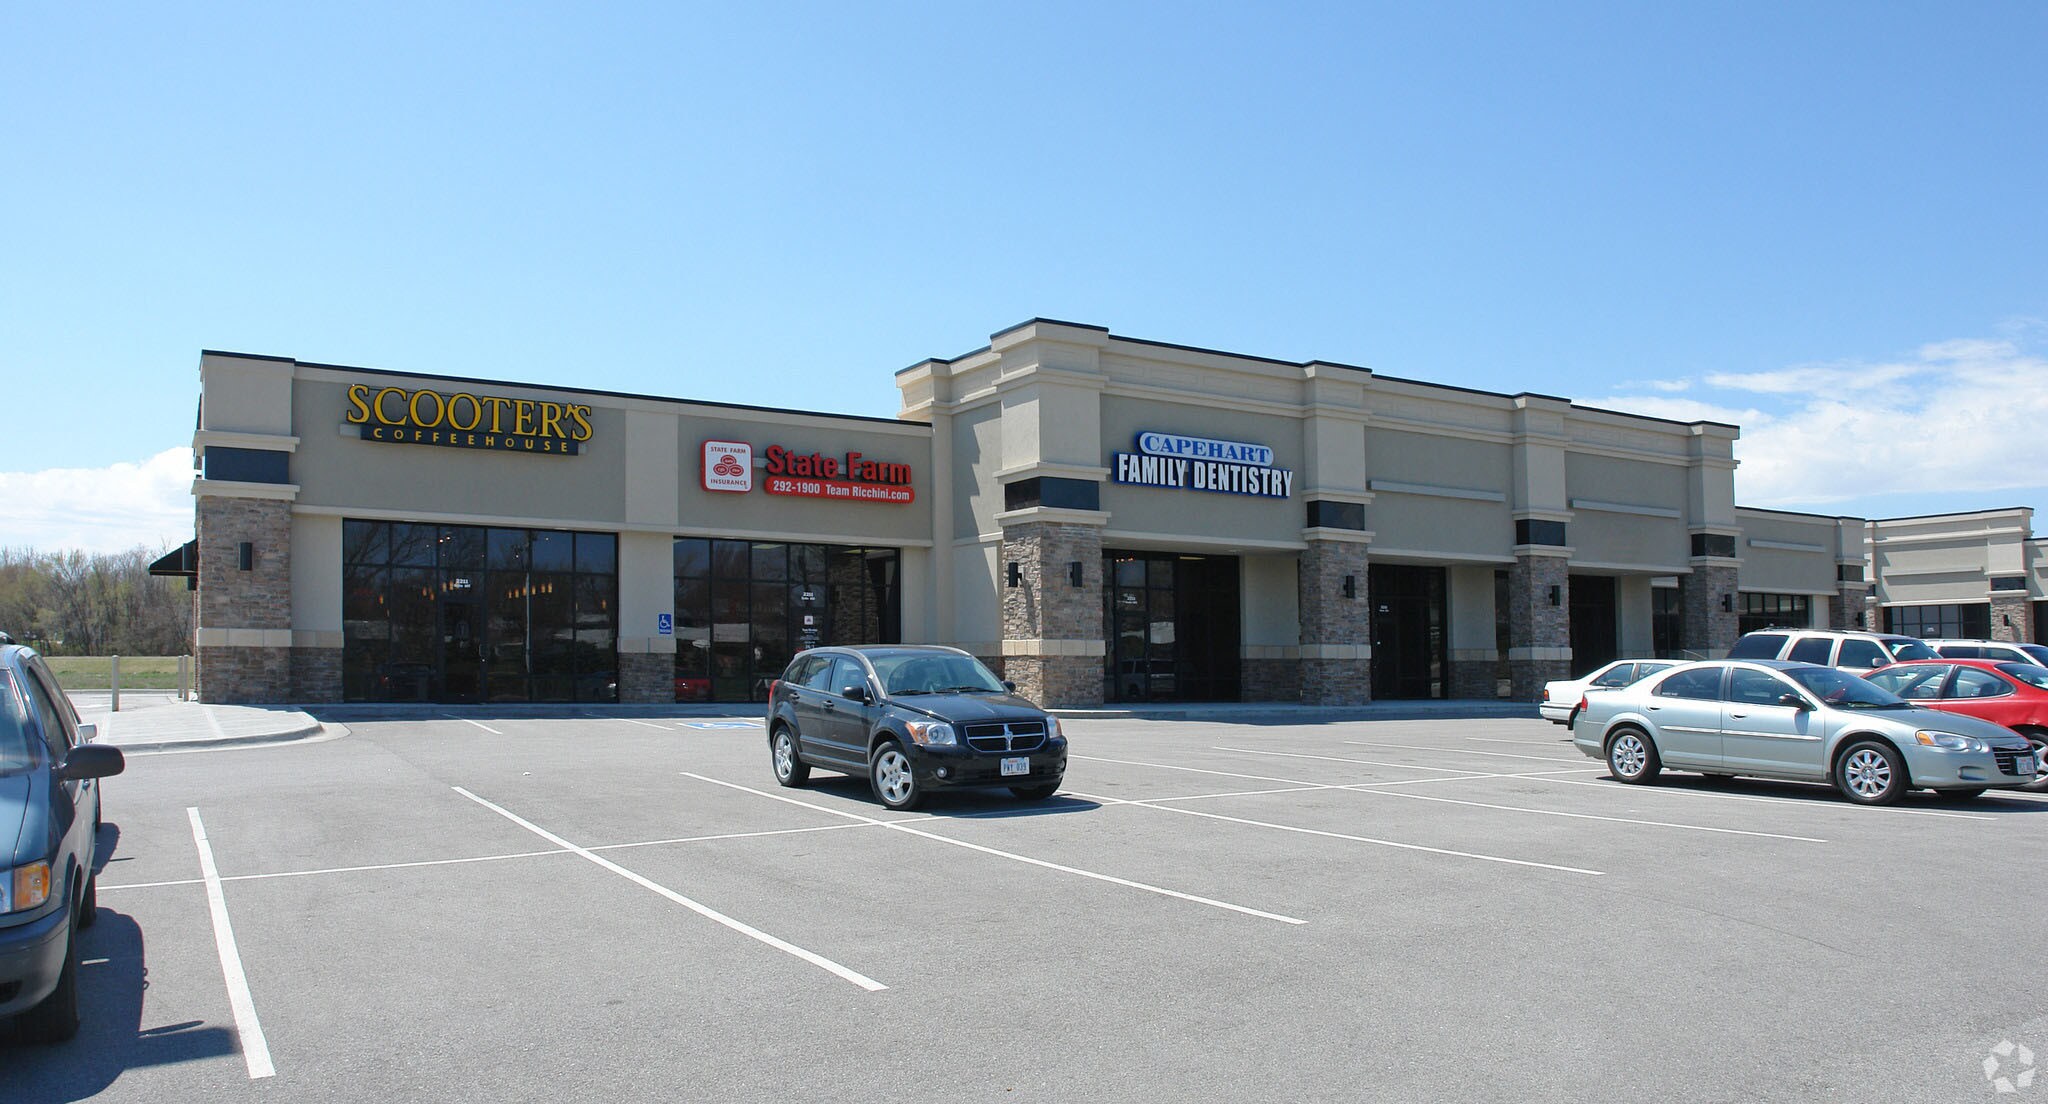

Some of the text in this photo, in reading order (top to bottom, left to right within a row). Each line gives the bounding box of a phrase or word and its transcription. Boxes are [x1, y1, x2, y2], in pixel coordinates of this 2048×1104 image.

[347, 384, 593, 441] SCOOTER'S
[373, 427, 568, 452] COFFEEHOUSE
[1144, 435, 1270, 463] CAPEHART
[766, 444, 912, 484] State Farm
[1117, 453, 1293, 497] FAMILY DENTISTRY
[710, 478, 747, 487] INSURANCE
[773, 480, 910, 501] 292-1900 Team Ricchini.com
